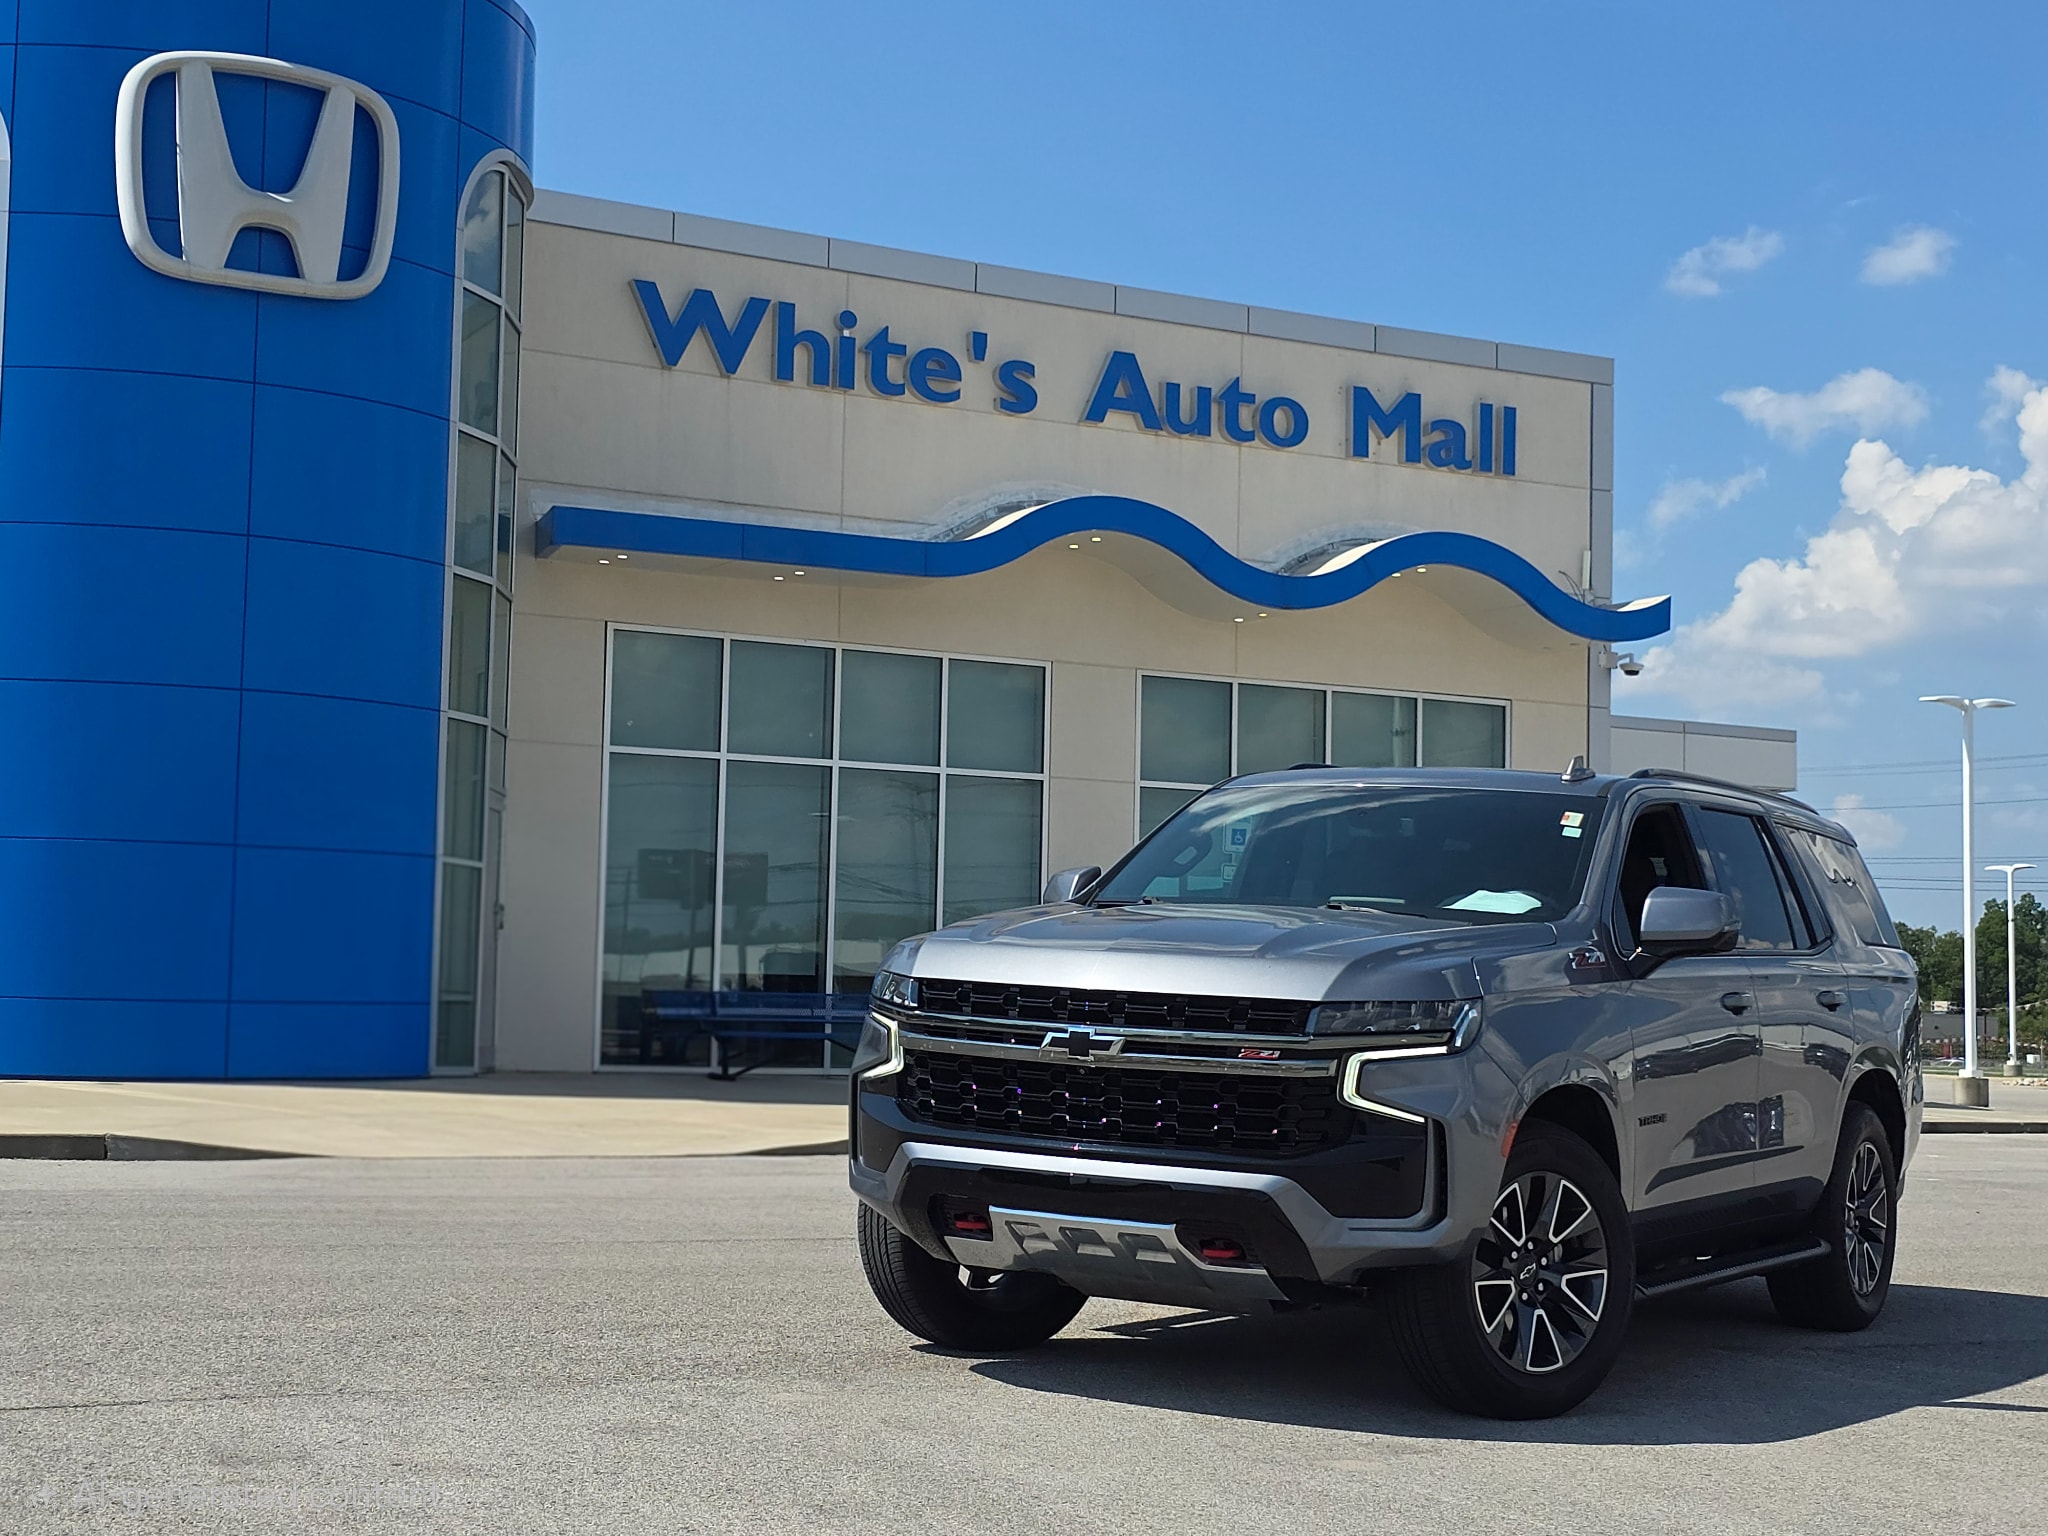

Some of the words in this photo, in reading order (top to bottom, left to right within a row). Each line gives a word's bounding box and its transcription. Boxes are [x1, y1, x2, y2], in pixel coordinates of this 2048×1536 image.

[629, 279, 1037, 416] White's
[1080, 350, 1310, 448] Auto
[1346, 385, 1517, 477] Mall
